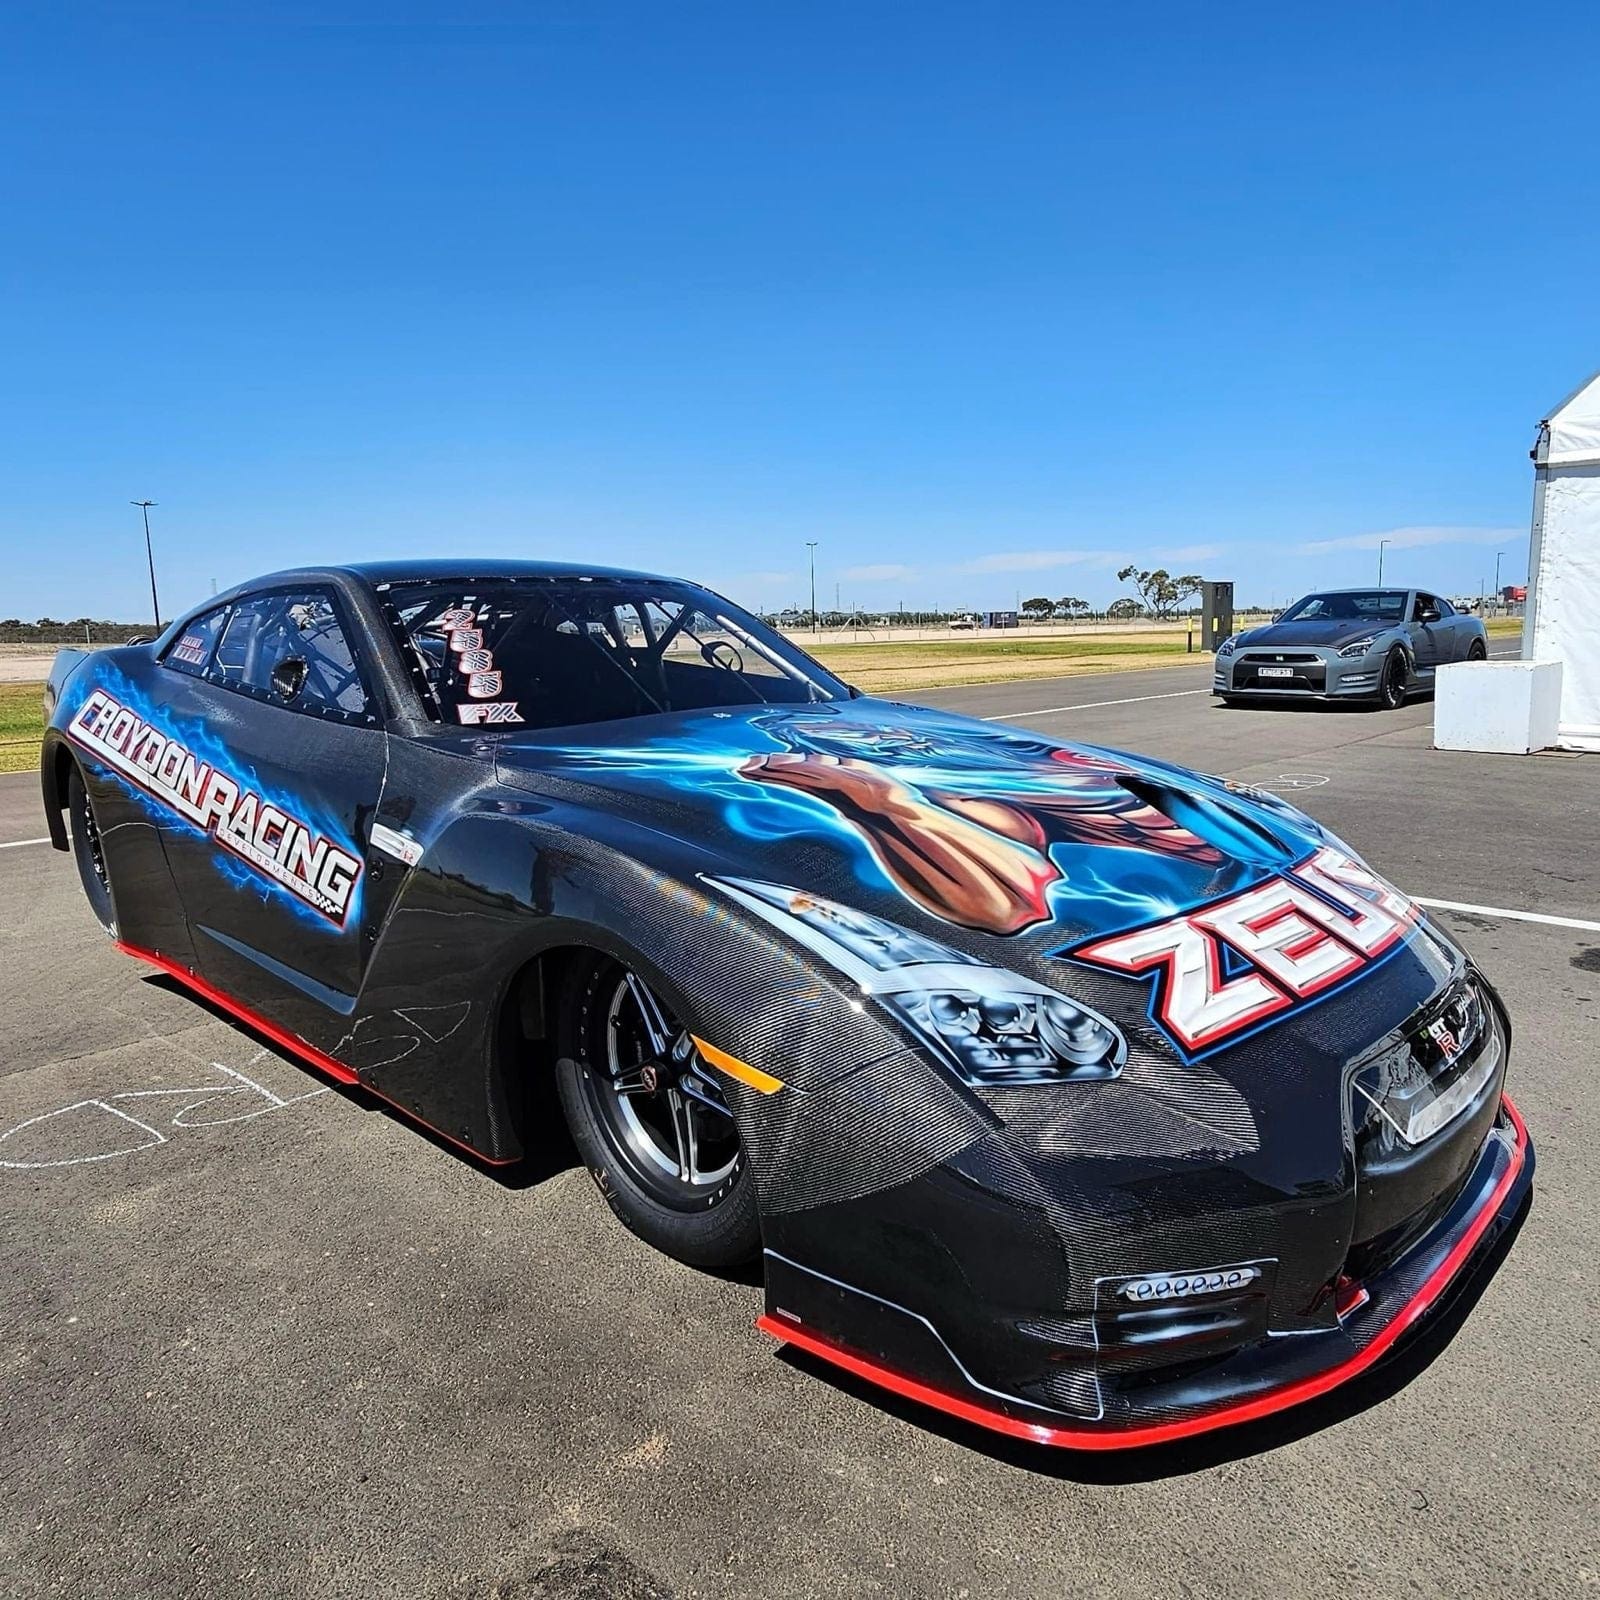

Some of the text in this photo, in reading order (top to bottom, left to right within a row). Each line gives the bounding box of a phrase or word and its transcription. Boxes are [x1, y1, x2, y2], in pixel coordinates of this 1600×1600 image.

[68, 690, 361, 907] CROYDON RACING
[219, 828, 317, 900] DEVELOPMENTS
